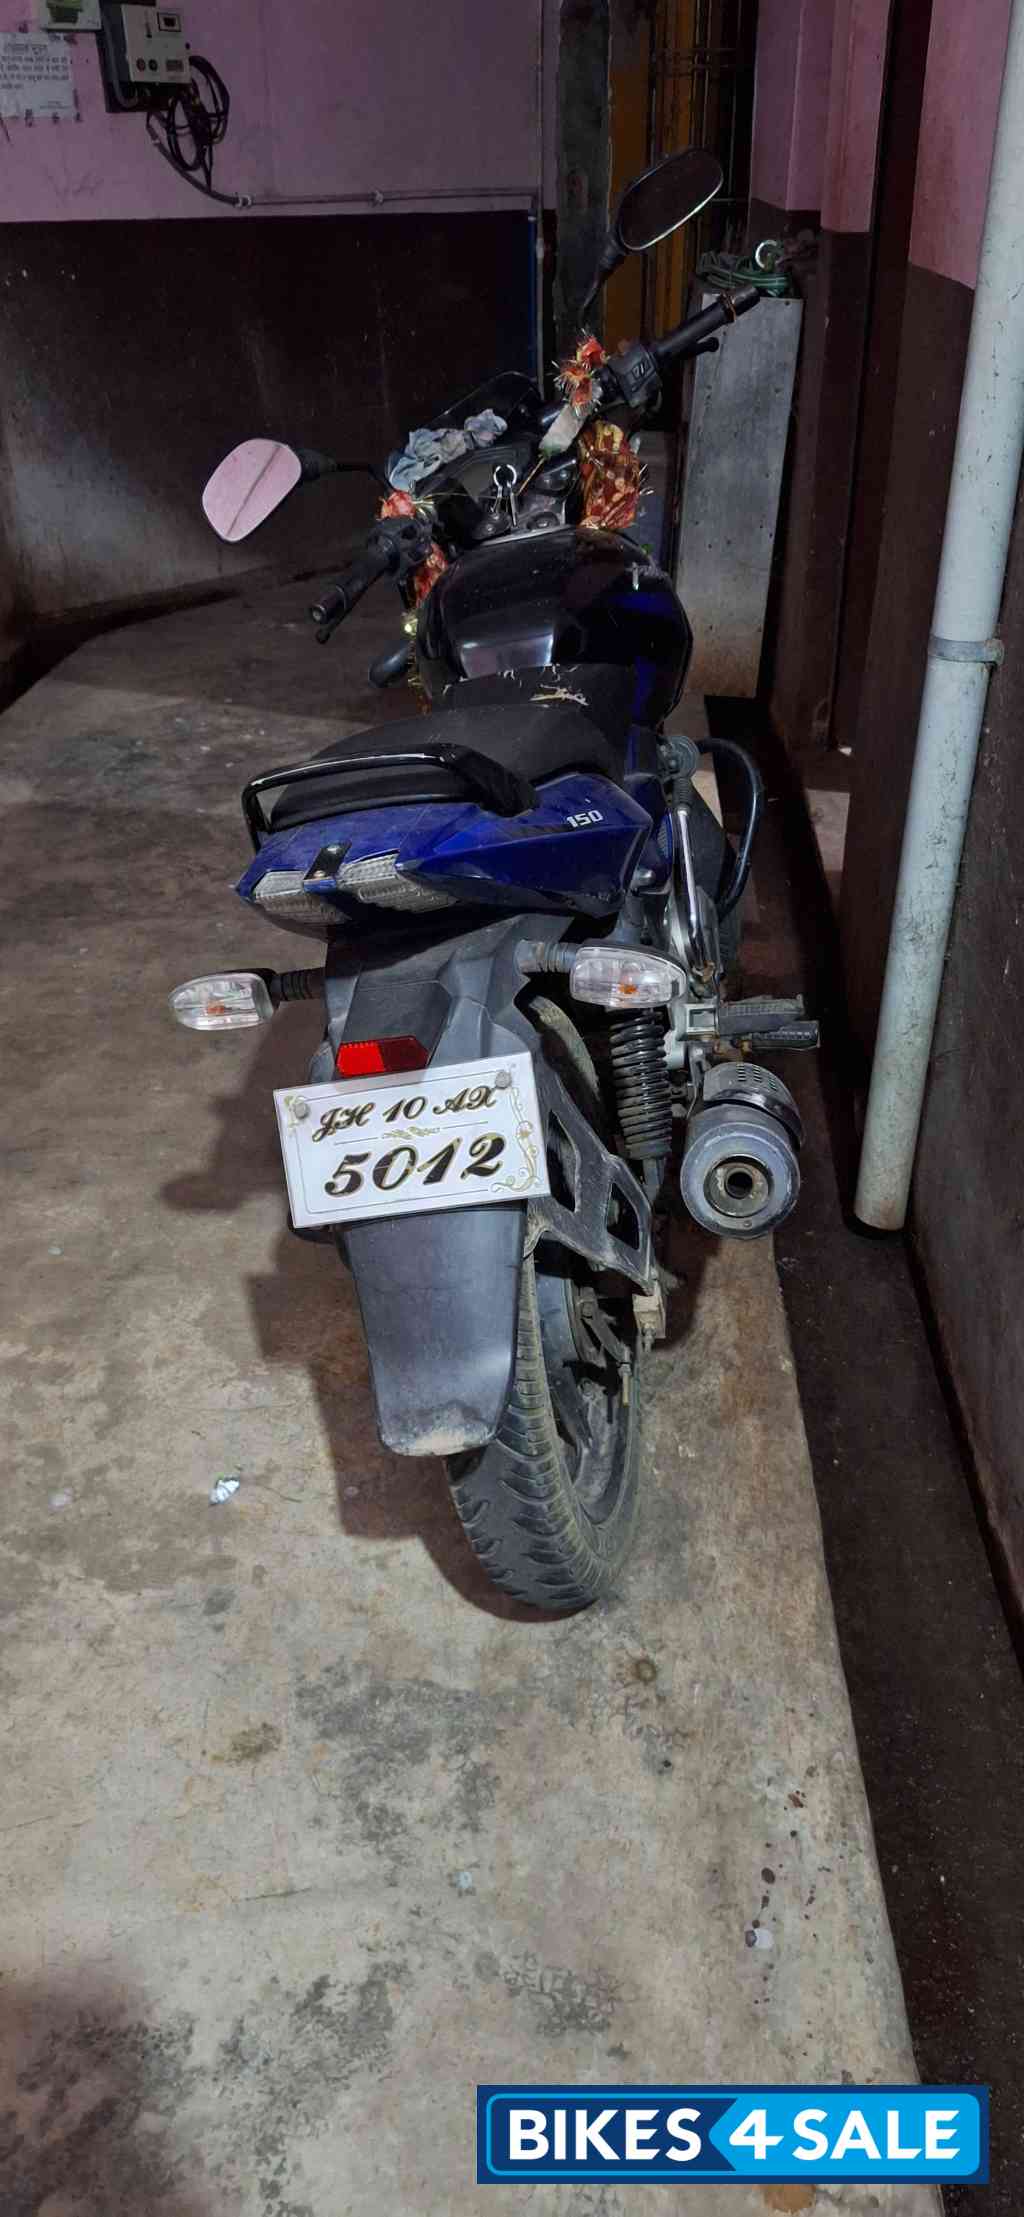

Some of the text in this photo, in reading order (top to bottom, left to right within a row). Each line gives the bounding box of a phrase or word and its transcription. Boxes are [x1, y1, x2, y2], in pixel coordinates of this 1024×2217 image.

[567, 810, 604, 828] 150
[312, 1102, 376, 1142] JH
[383, 1096, 427, 1122] 10
[324, 1132, 506, 1197] 5012
